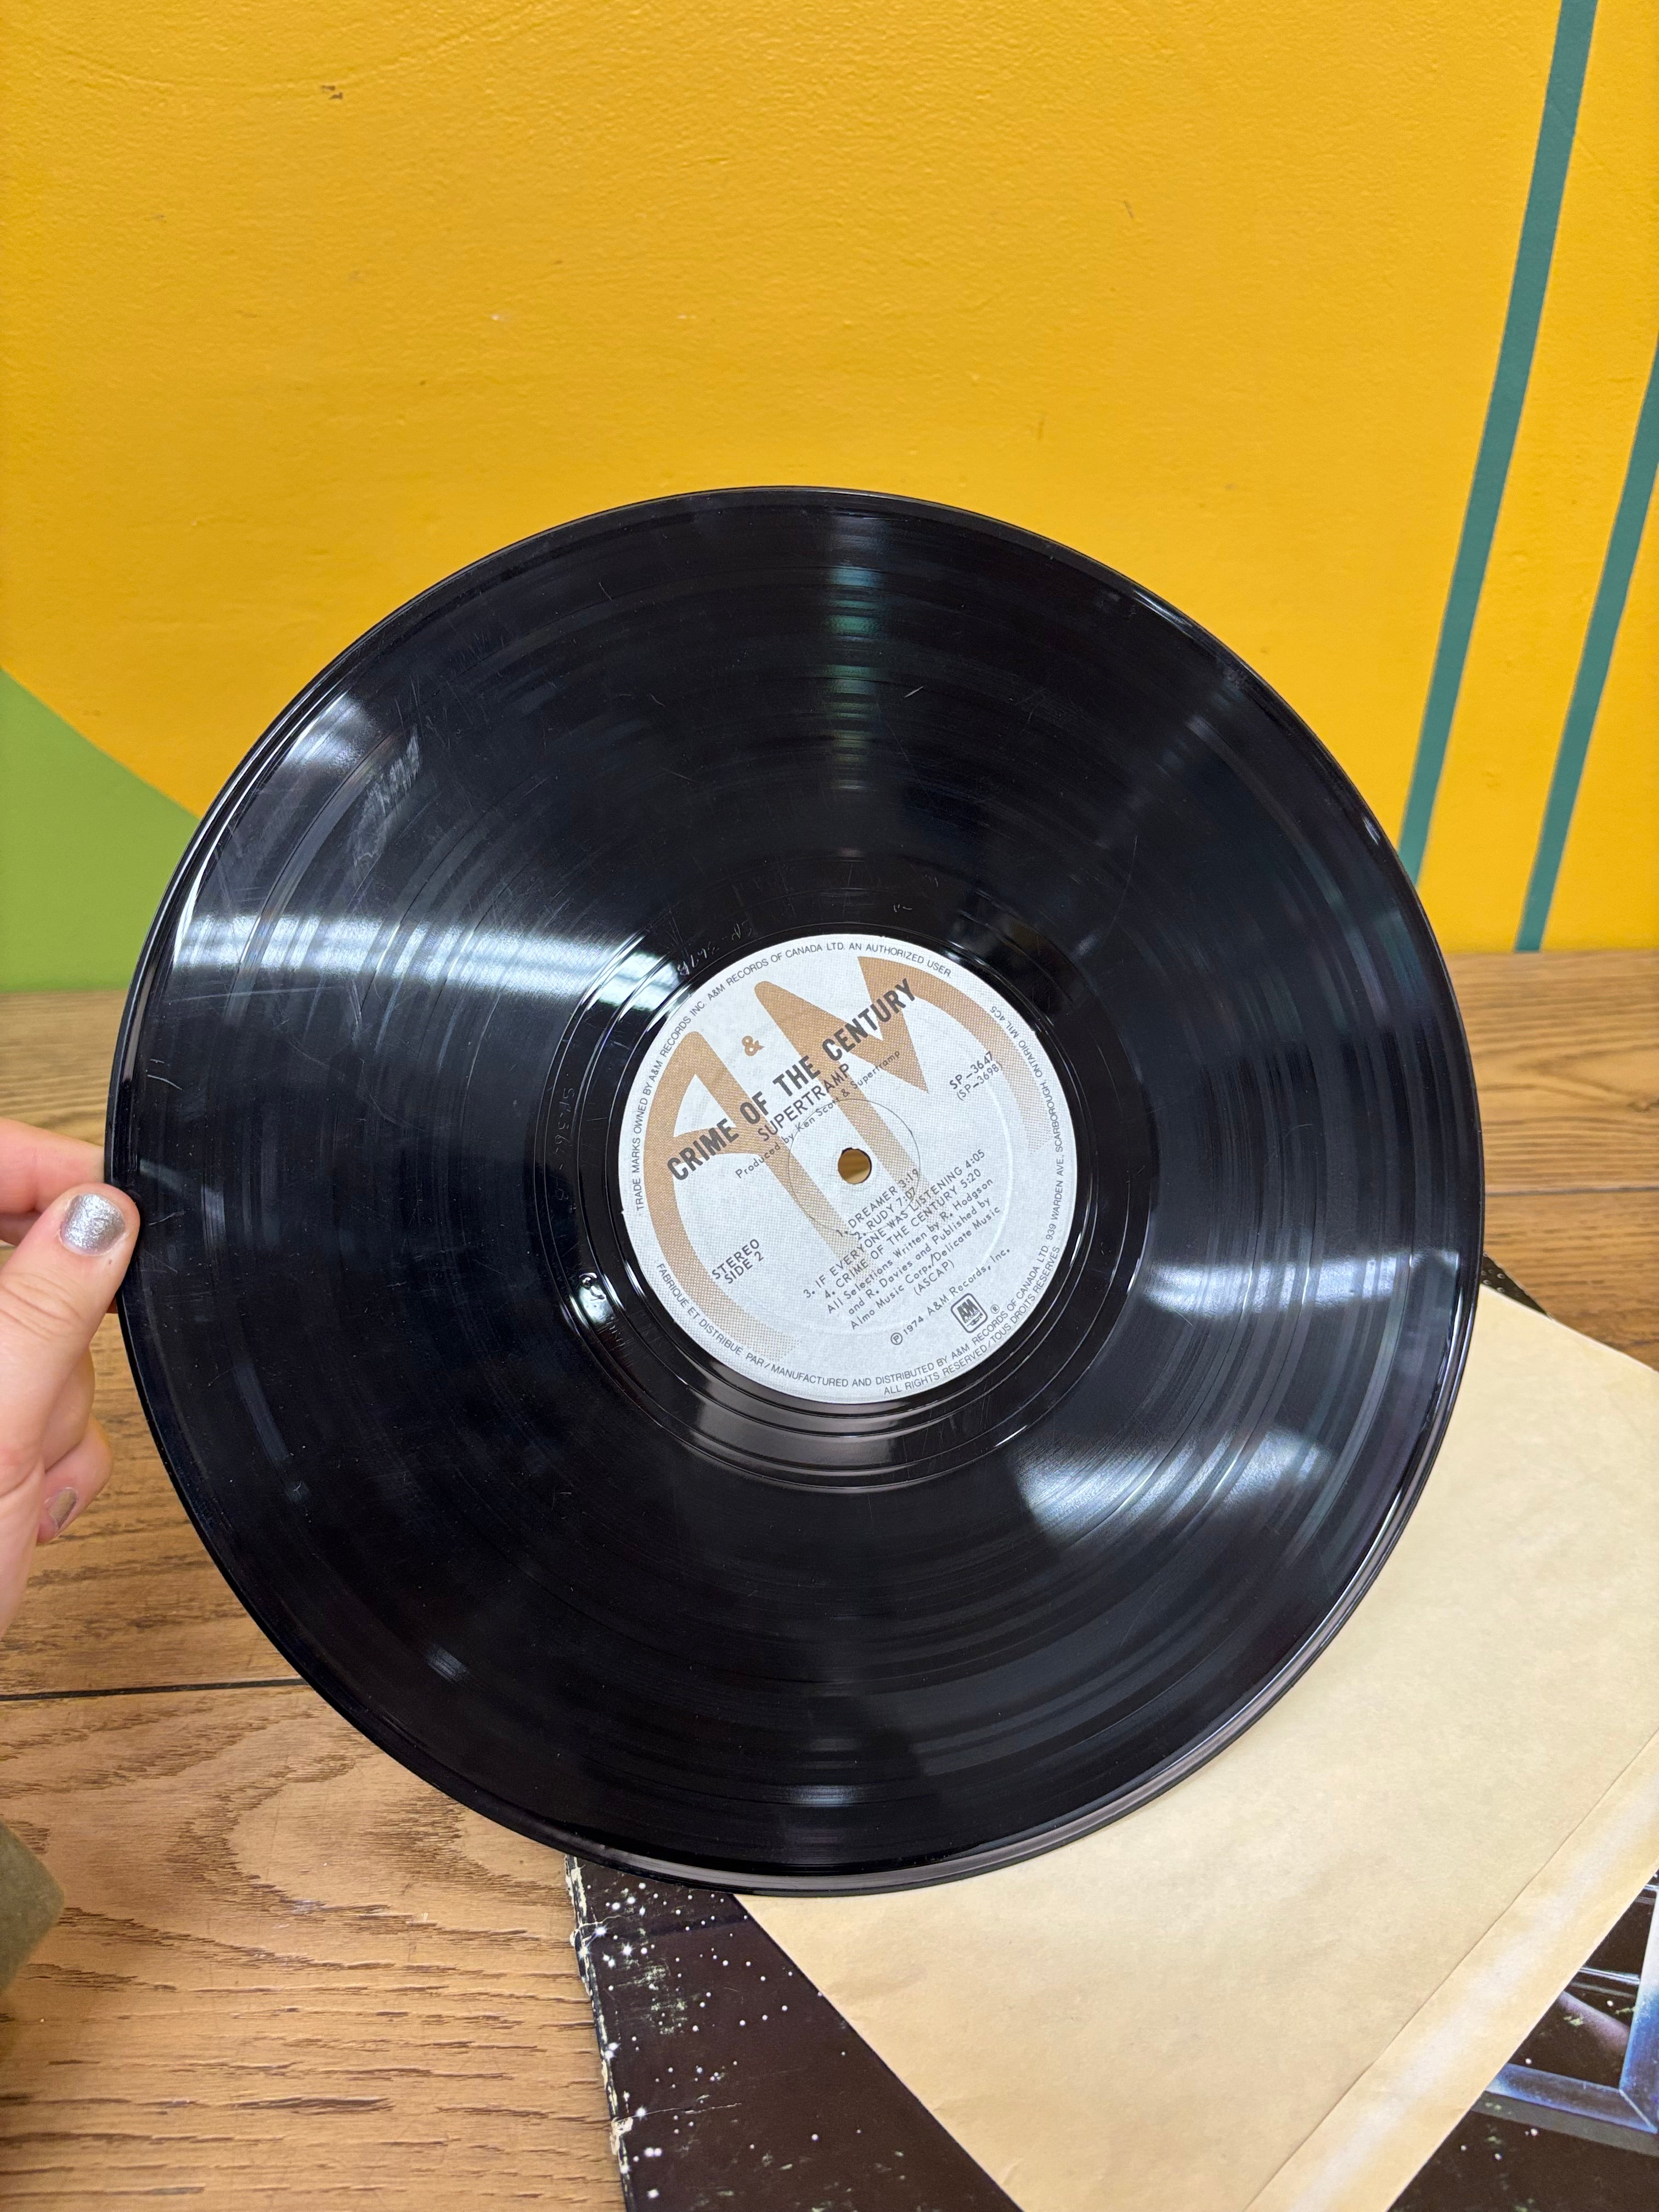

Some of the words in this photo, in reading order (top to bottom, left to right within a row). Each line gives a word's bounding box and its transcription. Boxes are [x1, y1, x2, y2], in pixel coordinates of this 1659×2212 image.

[770, 952, 782, 963] OF
[785, 944, 822, 958] CANADA
[866, 945, 924, 964] AUTHORIZED
[726, 958, 769, 986] RECORDS
[690, 1001, 707, 1017] INC.
[707, 984, 726, 1001] A&M
[990, 1006, 1006, 1021] 4C5
[661, 1016, 691, 1058] RECORDS
[651, 1060, 663, 1082] A&M
[1018, 1040, 1042, 1077] ONTARIO
[642, 1081, 653, 1096] BY
[667, 1118, 739, 1180] CRIME
[740, 1091, 769, 1125] OF
[772, 1056, 821, 1097] THE
[822, 978, 915, 1061] CENTURY
[633, 1098, 648, 1134] OWNED
[735, 1143, 781, 1179] Produced
[781, 1133, 794, 1145] by
[795, 1117, 816, 1132] Ken
[815, 1097, 840, 1116] Scott
[842, 1089, 850, 1098] &
[851, 1051, 900, 1089] Supertramp
[758, 1063, 849, 1142] SUPERTRAMP
[1041, 1079, 1063, 1153] SCARBOROUGH,
[632, 1138, 641, 1173] MARKS
[632, 1178, 644, 1211] TRADE
[836, 1229, 848, 1238] 1.
[848, 1186, 898, 1228] DREAMER
[899, 1169, 919, 1188] 3:19
[1051, 1181, 1063, 1221] WARDEN
[803, 1289, 815, 1299] 3.
[815, 1274, 827, 1288] IF
[829, 1226, 887, 1277] EVERYONE
[887, 1210, 909, 1228] WAS
[907, 1166, 963, 1212] LISTENING
[965, 1149, 985, 1169] 4:05
[854, 1232, 867, 1240] 2.
[866, 1203, 895, 1231] RUDY
[896, 1187, 916, 1207] 7:07
[824, 1290, 836, 1299] 4.
[836, 1259, 870, 1288] CRIME
[870, 1245, 885, 1260] OF
[886, 1226, 910, 1246] THE
[911, 1185, 958, 1227] CENTURY
[960, 1169, 981, 1188] 5:20
[827, 1297, 844, 1313] All
[844, 1259, 893, 1299] Selections
[893, 1232, 927, 1259] Written
[927, 1222, 940, 1235] by
[939, 1208, 953, 1222] R.
[952, 1178, 994, 1211] Hodgson
[1046, 1223, 1056, 1240] 939
[712, 1239, 759, 1279] STEREO
[725, 1259, 753, 1284] SIDE
[754, 1251, 764, 1262] 2
[849, 1297, 865, 1315] and
[865, 1289, 879, 1299] R.
[879, 1261, 913, 1288] Davies
[916, 1244, 932, 1260] and
[932, 1208, 978, 1245] Published
[978, 1198, 990, 1208] by
[850, 1310, 875, 1330] Almo
[876, 1285, 904, 1309] Music
[972, 1207, 1000, 1230] Music
[903, 1316, 924, 1335] 1974
[927, 1295, 950, 1316] A&M
[949, 1266, 991, 1297] Records,
[990, 1249, 1010, 1263] Inc.
[913, 1259, 955, 1296] (ASCAP)
[1016, 1267, 1040, 1299] CANADA
[687, 1307, 700, 1319] ET
[1007, 1299, 1017, 1311] OF
[884, 1385, 902, 1395] ALL
[905, 1373, 940, 1390] RIGHTS
[1011, 1294, 1035, 1323] DROITS
[972, 1311, 1008, 1346] RECORDS
[936, 1356, 948, 1368] BY
[951, 1344, 970, 1359] A&M
[852, 1378, 871, 1387] AND
[876, 1363, 934, 1385] DISTRIBUTED
